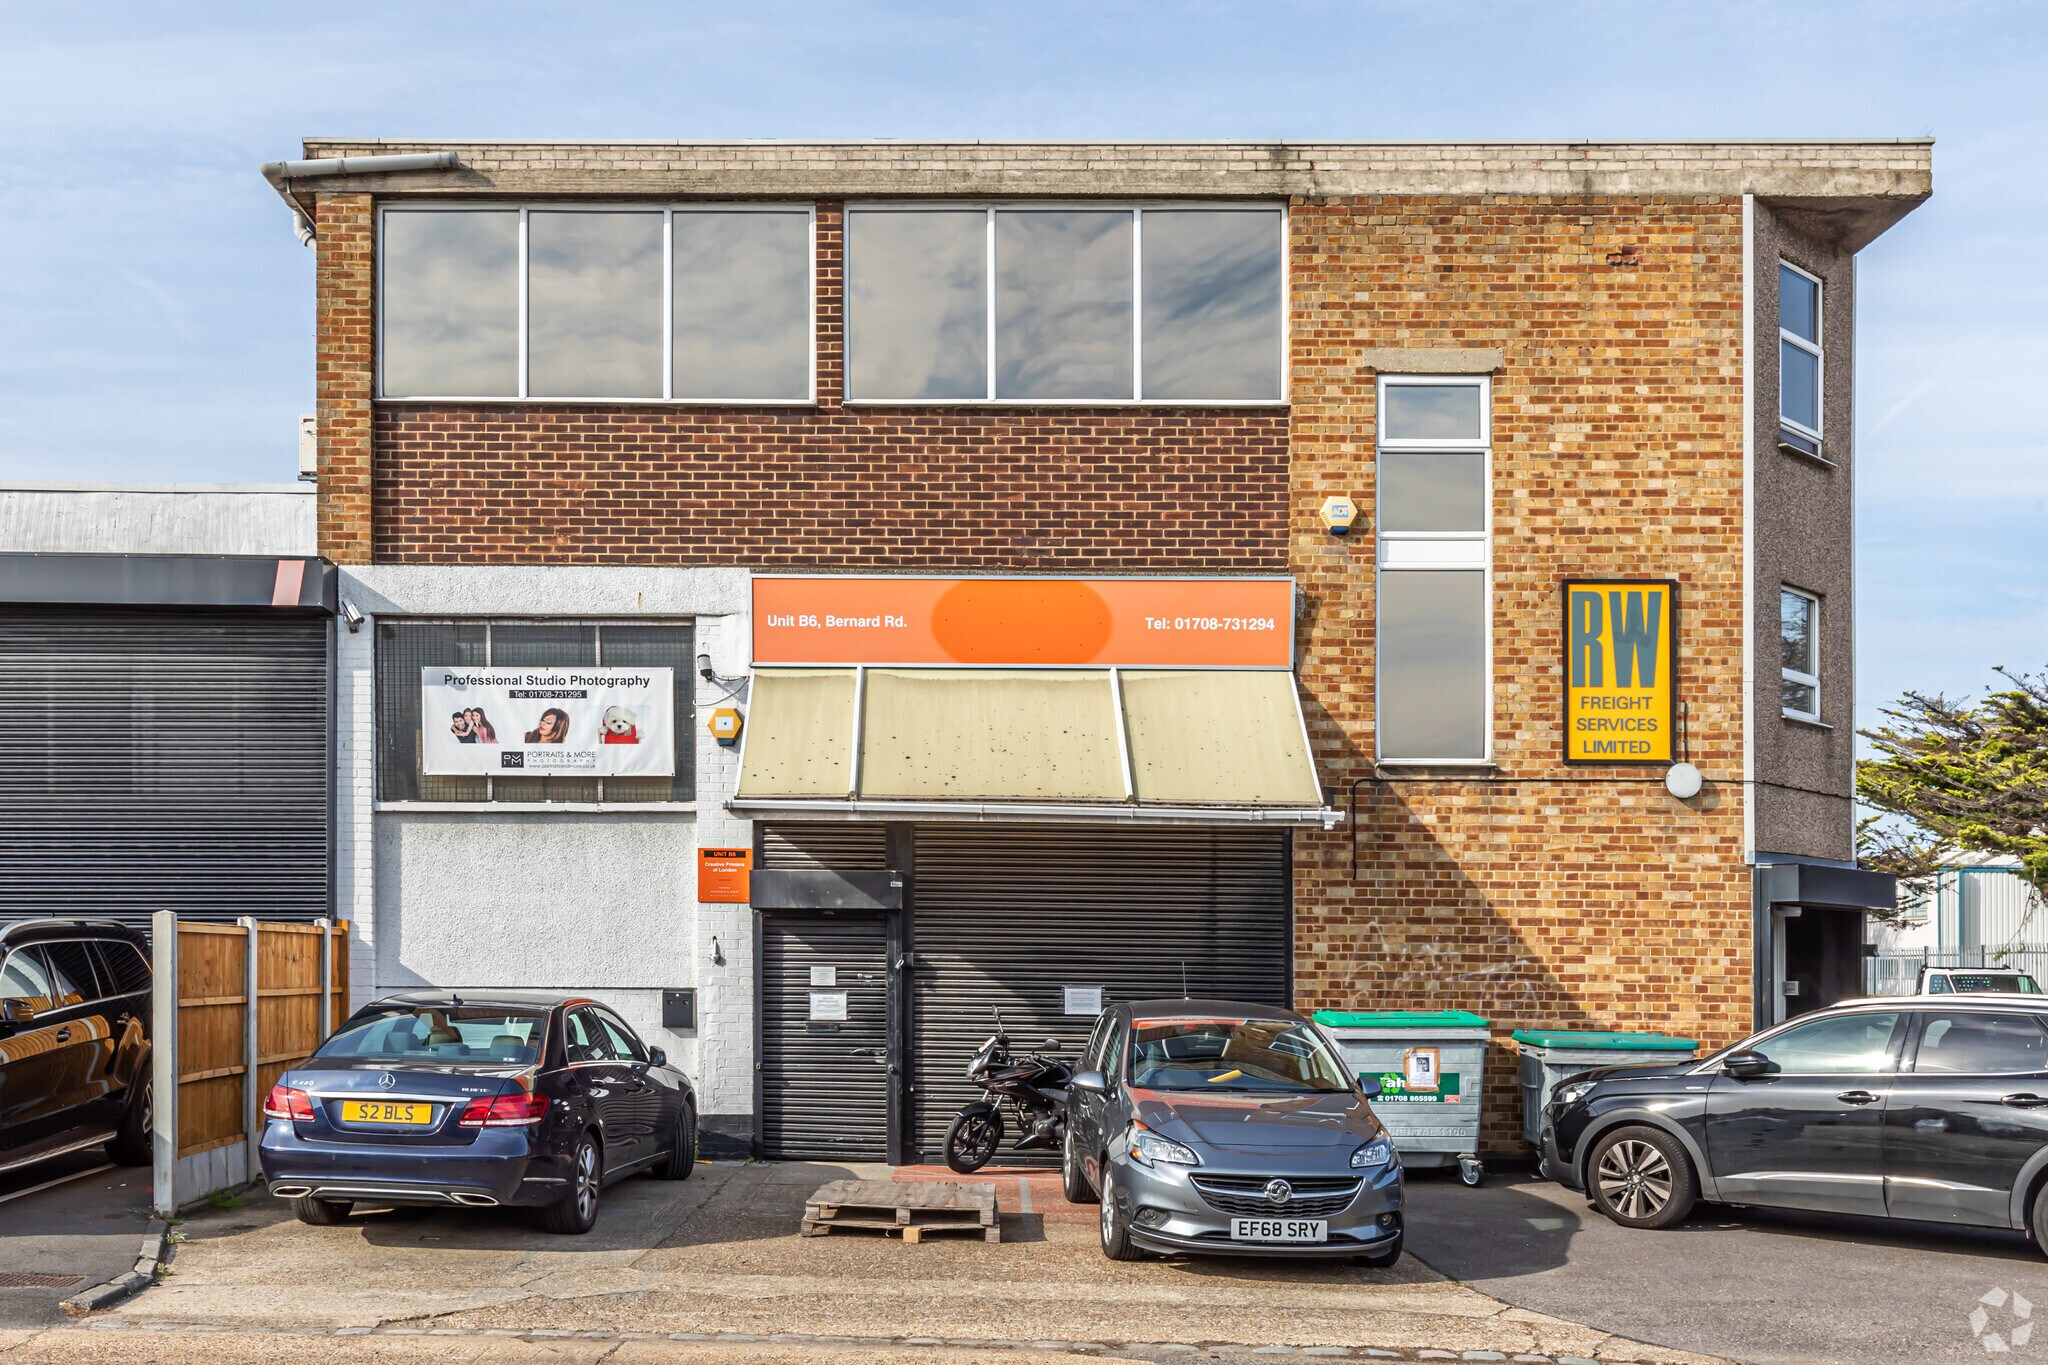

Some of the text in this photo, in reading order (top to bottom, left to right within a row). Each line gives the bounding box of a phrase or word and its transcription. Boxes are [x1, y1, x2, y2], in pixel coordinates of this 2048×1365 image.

[767, 614, 907, 629] Unit B6, Bernard Rd.
[1145, 617, 1275, 631] Tel: 01708-731294
[1572, 591, 1662, 688] RW
[444, 674, 650, 688] Professional Studio Photography
[513, 690, 582, 698] Tel: 01708-731295
[1581, 696, 1653, 710] FREIGHT
[1576, 717, 1658, 732] SERVICES
[1583, 740, 1651, 754] LIMITED
[1239, 1221, 1320, 1238] EF68 SRY
